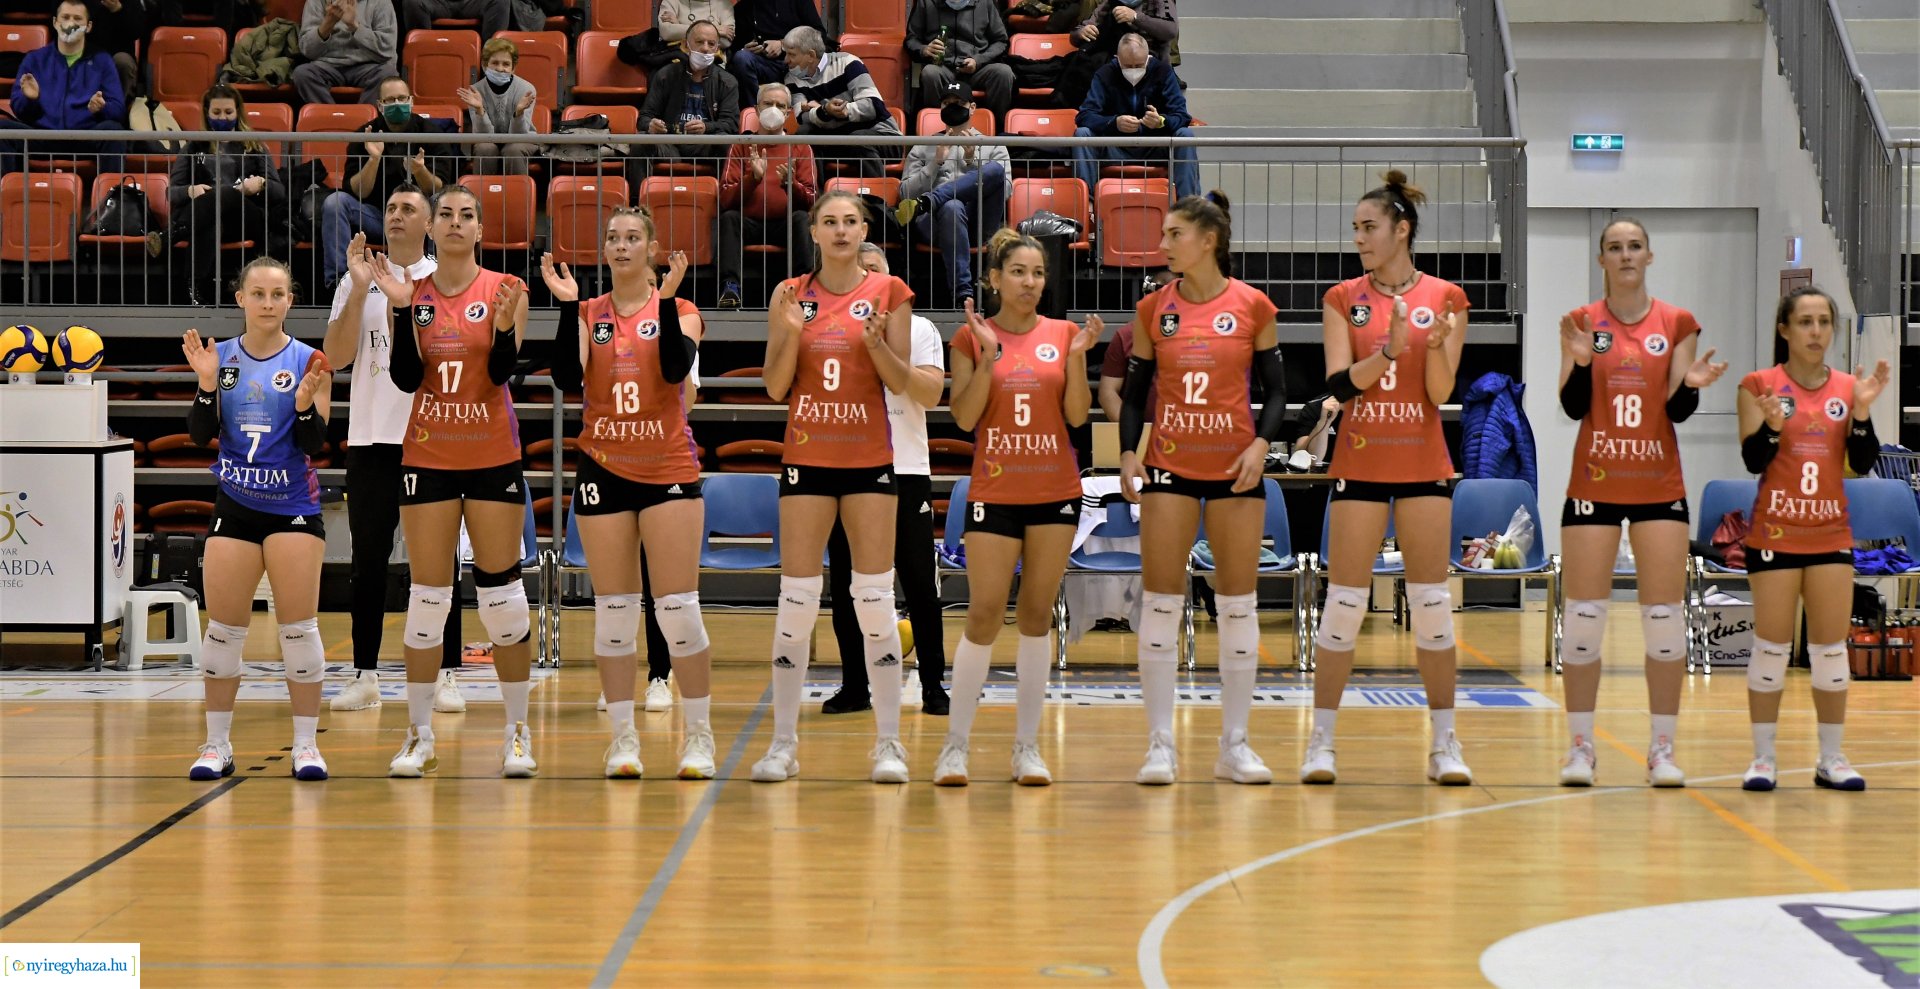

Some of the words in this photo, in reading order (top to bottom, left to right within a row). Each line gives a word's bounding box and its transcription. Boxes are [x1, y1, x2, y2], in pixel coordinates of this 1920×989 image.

[368, 330, 390, 348] FA
[438, 361, 463, 393] 17
[823, 358, 840, 391] 9
[1380, 360, 1397, 391] 3
[612, 381, 640, 414] 13
[1182, 371, 1209, 405] 12
[418, 393, 489, 419] FATUM
[795, 394, 868, 419] FATUM
[1014, 393, 1031, 427] 5
[1161, 403, 1234, 430] FATUM
[1352, 395, 1424, 418] FATUM
[1612, 394, 1642, 428] 18
[594, 416, 664, 437] FATUM
[985, 426, 1058, 450] FATUM
[247, 432, 261, 463] 7
[1590, 428, 1664, 455] FATUM
[220, 458, 290, 484] FATUM
[1153, 469, 1172, 484] 12
[1800, 461, 1819, 496] 8
[404, 474, 418, 495] 17
[579, 483, 600, 505] 13
[973, 502, 985, 522] 5
[1768, 489, 1842, 515] FATUM
[1713, 612, 1721, 620] K
